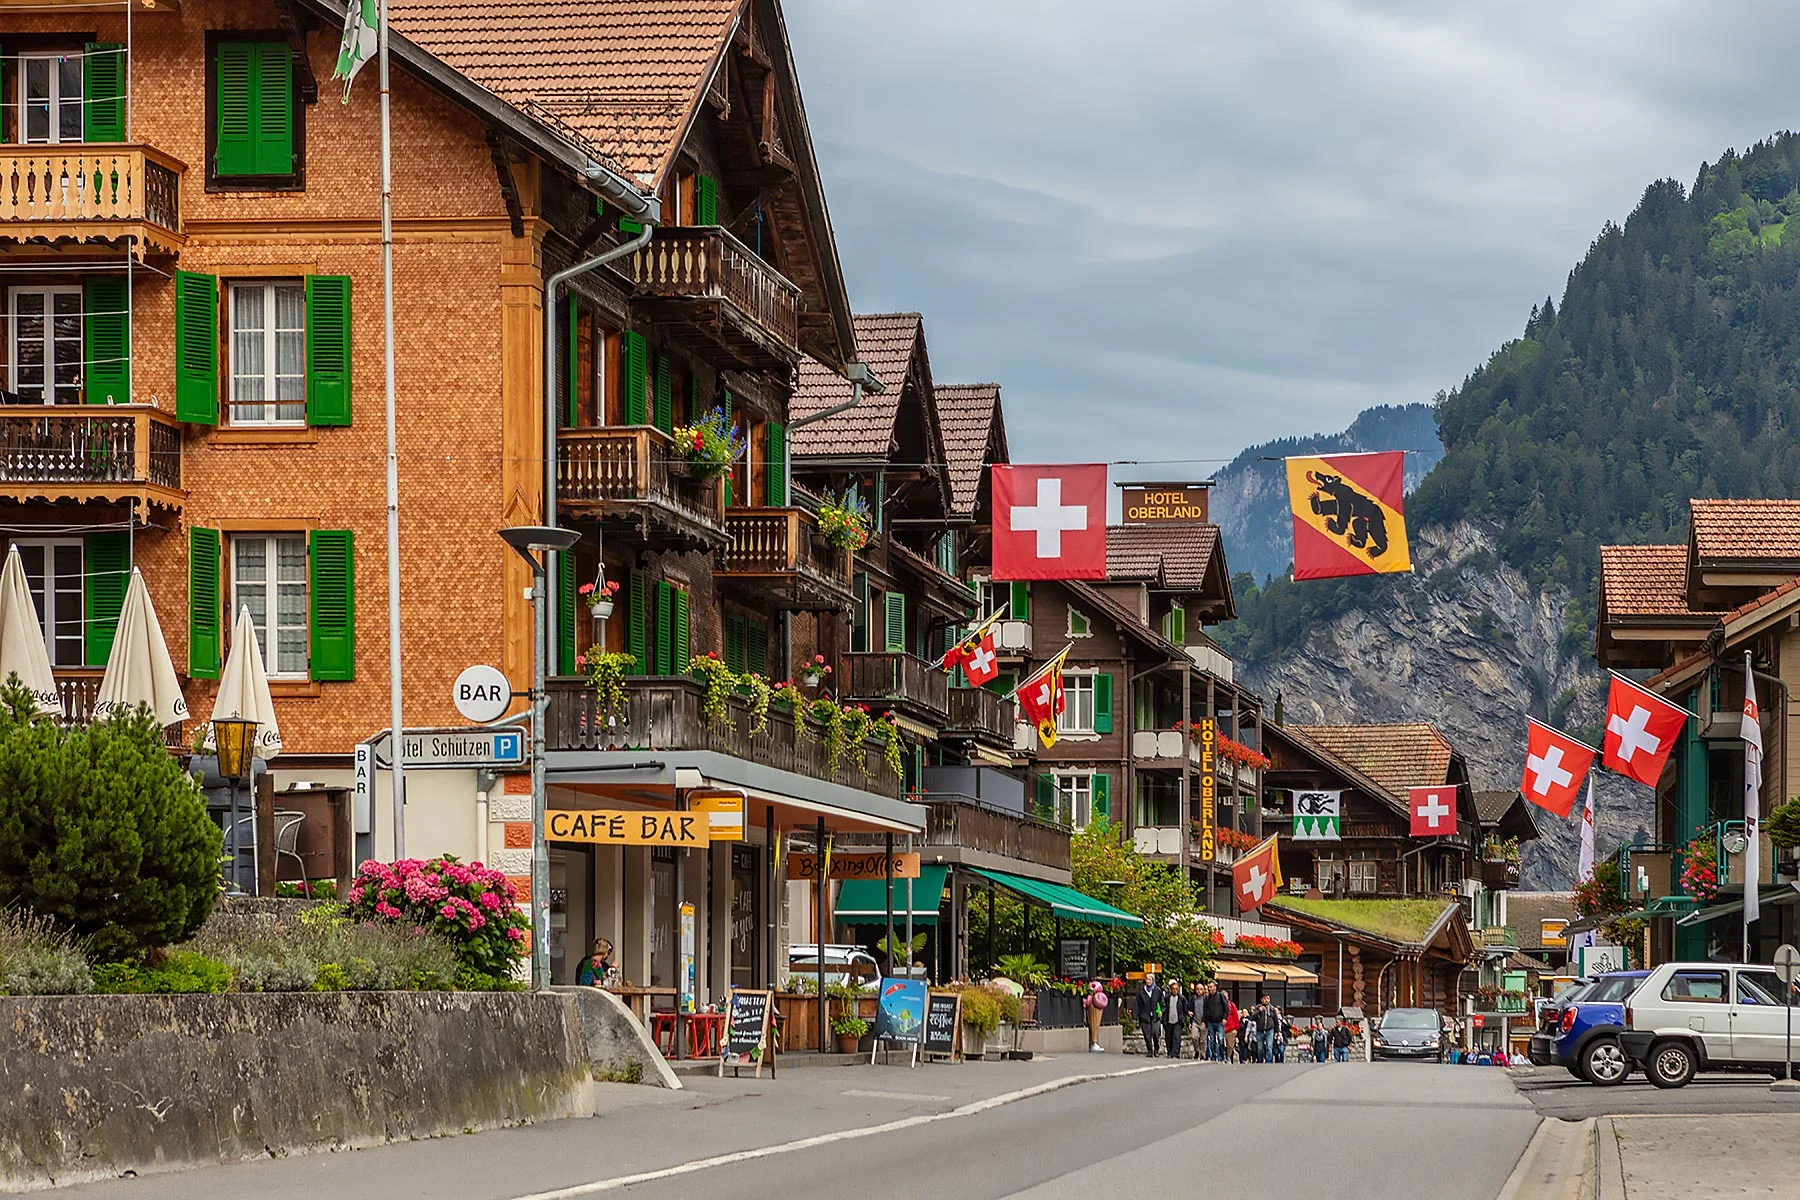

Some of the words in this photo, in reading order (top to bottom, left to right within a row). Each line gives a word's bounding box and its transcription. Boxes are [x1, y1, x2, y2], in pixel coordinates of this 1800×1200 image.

[1144, 492, 1188, 504] HOTEL
[1128, 506, 1201, 519] OBERLAND
[460, 684, 502, 701] BAR
[391, 738, 423, 757] tel
[432, 737, 490, 757] Schützen
[1202, 719, 1213, 772] HOTEL
[357, 750, 366, 793] BAR
[551, 814, 625, 838] CAFÉ
[641, 815, 695, 841] BAR
[1202, 776, 1213, 861] OBERLAND
